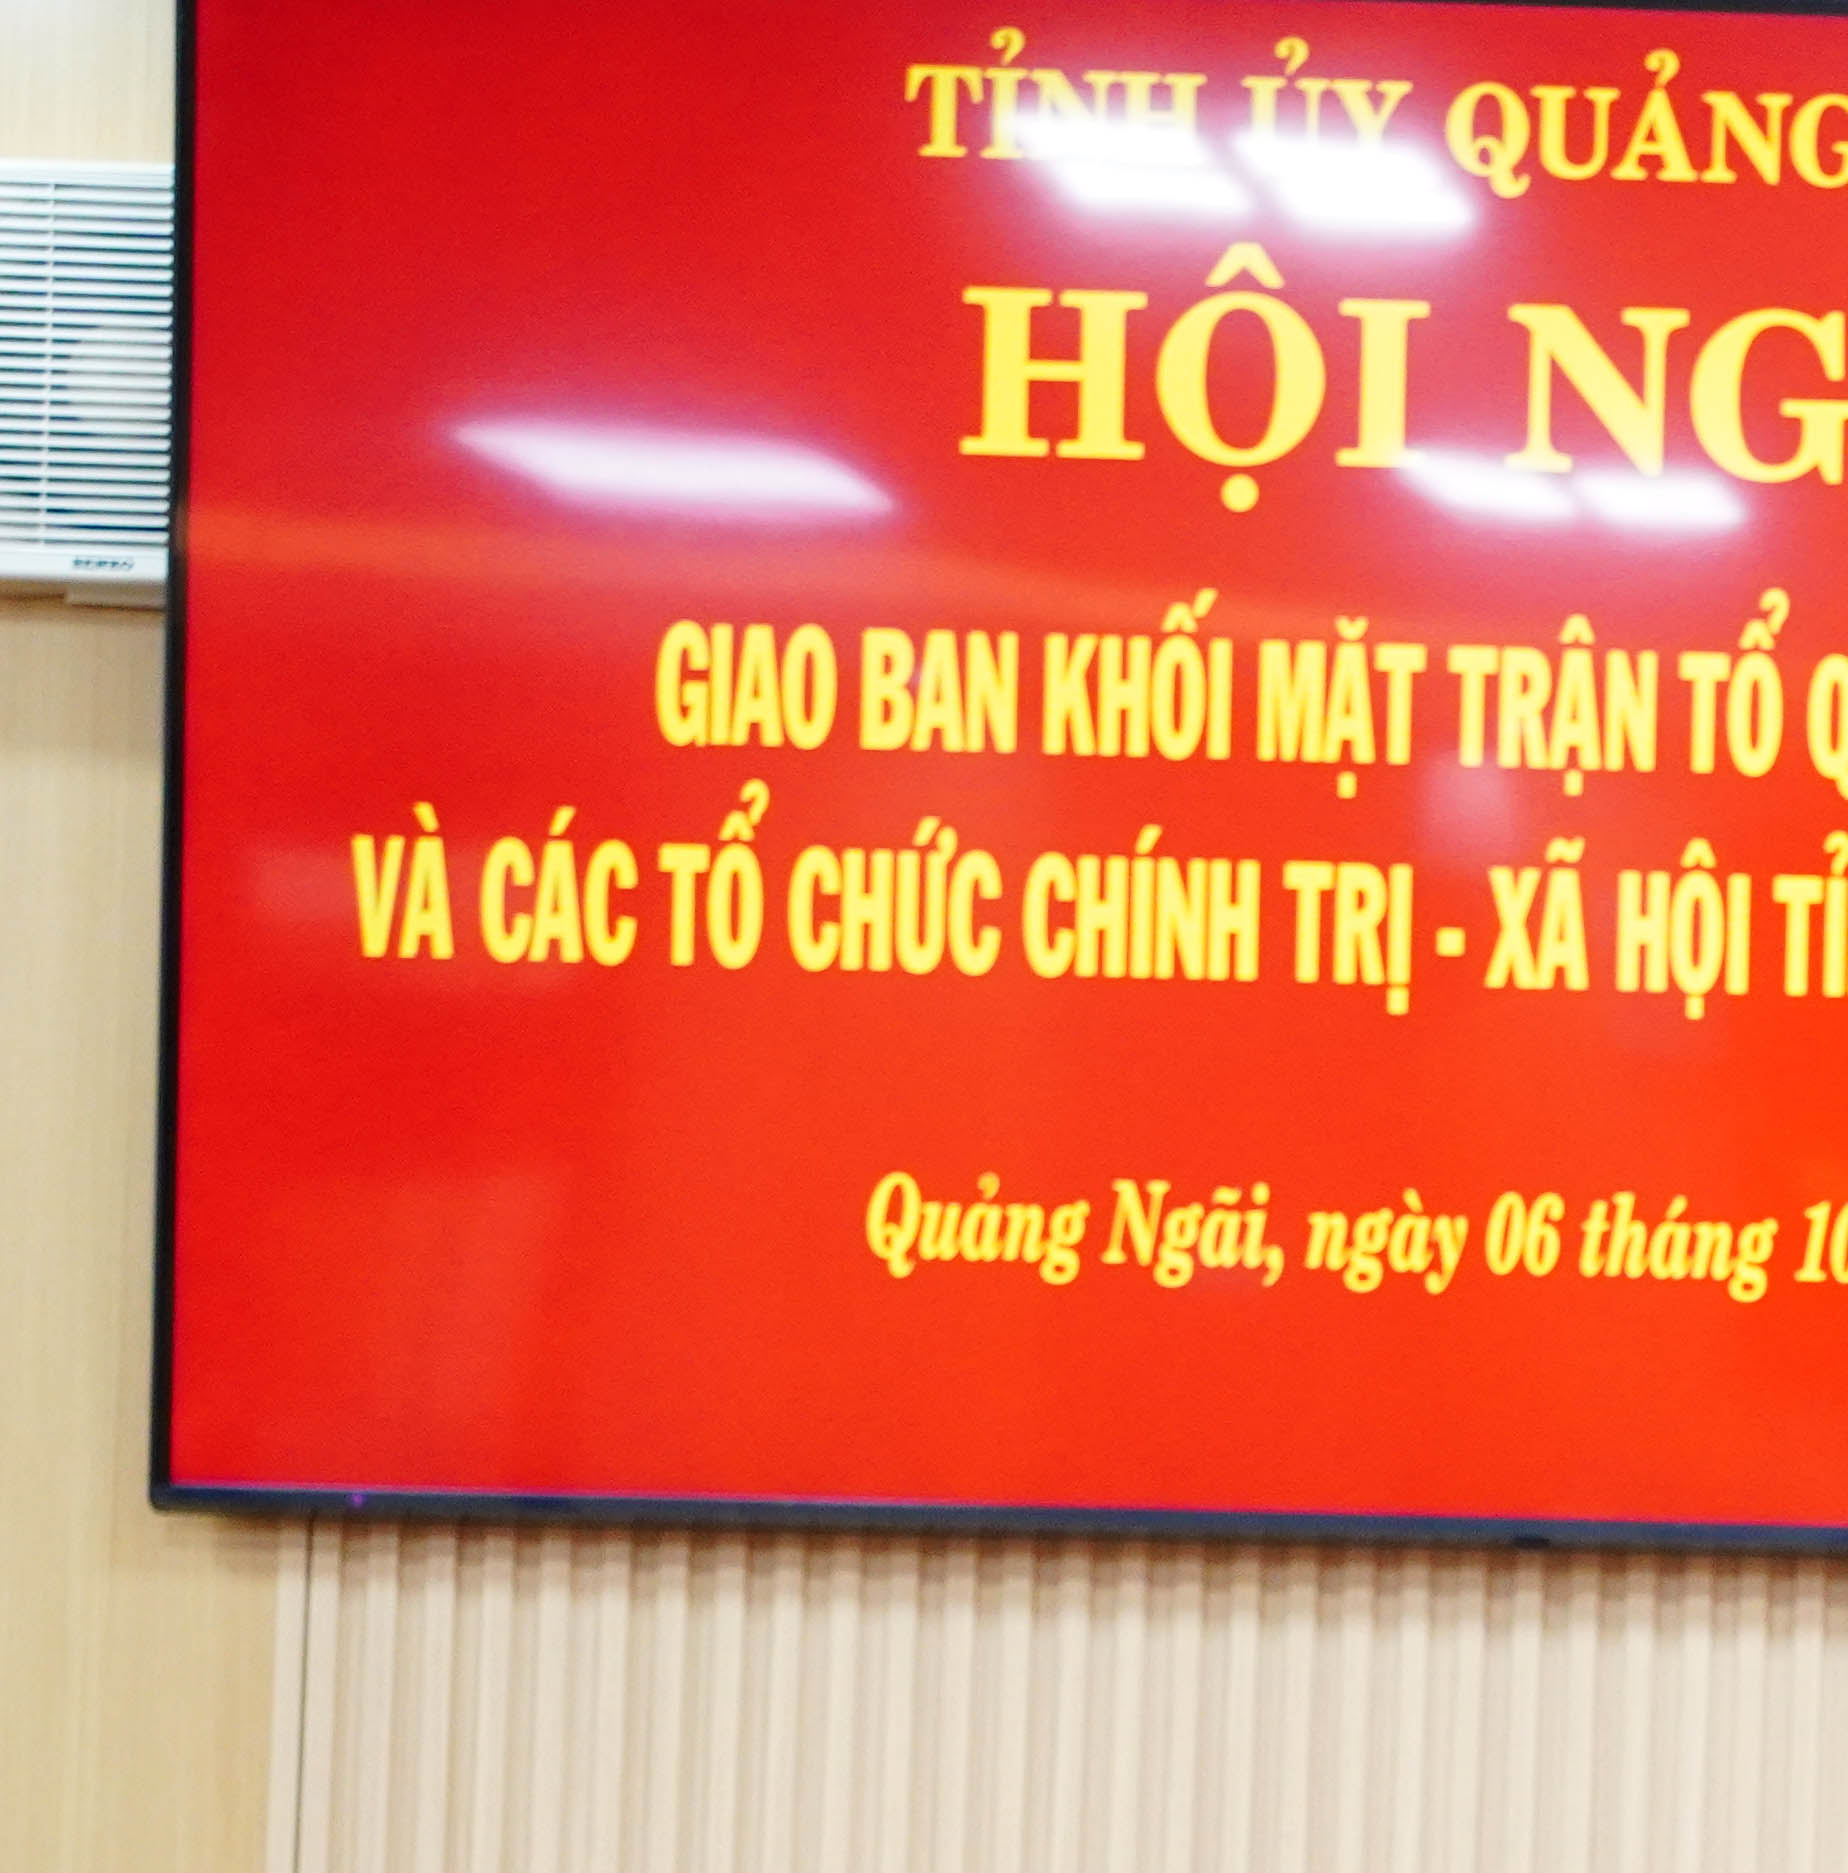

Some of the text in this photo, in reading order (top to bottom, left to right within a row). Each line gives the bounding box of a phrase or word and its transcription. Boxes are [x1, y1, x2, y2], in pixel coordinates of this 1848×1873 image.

[960, 248, 1428, 512] HỘI
[656, 621, 837, 750] GIAO
[860, 627, 1019, 753] BAN
[1042, 588, 1233, 760] KHỐI
[1257, 616, 1428, 798] MẶT
[1446, 615, 1659, 796] TRẬN
[1678, 588, 1789, 777] TỔ
[352, 803, 453, 959] VÀ
[480, 806, 638, 966] CÁC
[659, 780, 769, 969] TỔ
[788, 816, 1002, 976] CHỨC
[1022, 824, 1260, 981] CHÍNH
[1283, 862, 1413, 1015] TRỊ
[1485, 836, 1589, 991] XÃ
[1616, 838, 1751, 1020] HỘI
[866, 1172, 1090, 1285] Quảng
[1102, 1179, 1284, 1288] Ngãi,
[1305, 1189, 1468, 1294] ngày
[1485, 1192, 1565, 1276] 06
[1579, 1192, 1778, 1302] tháng
